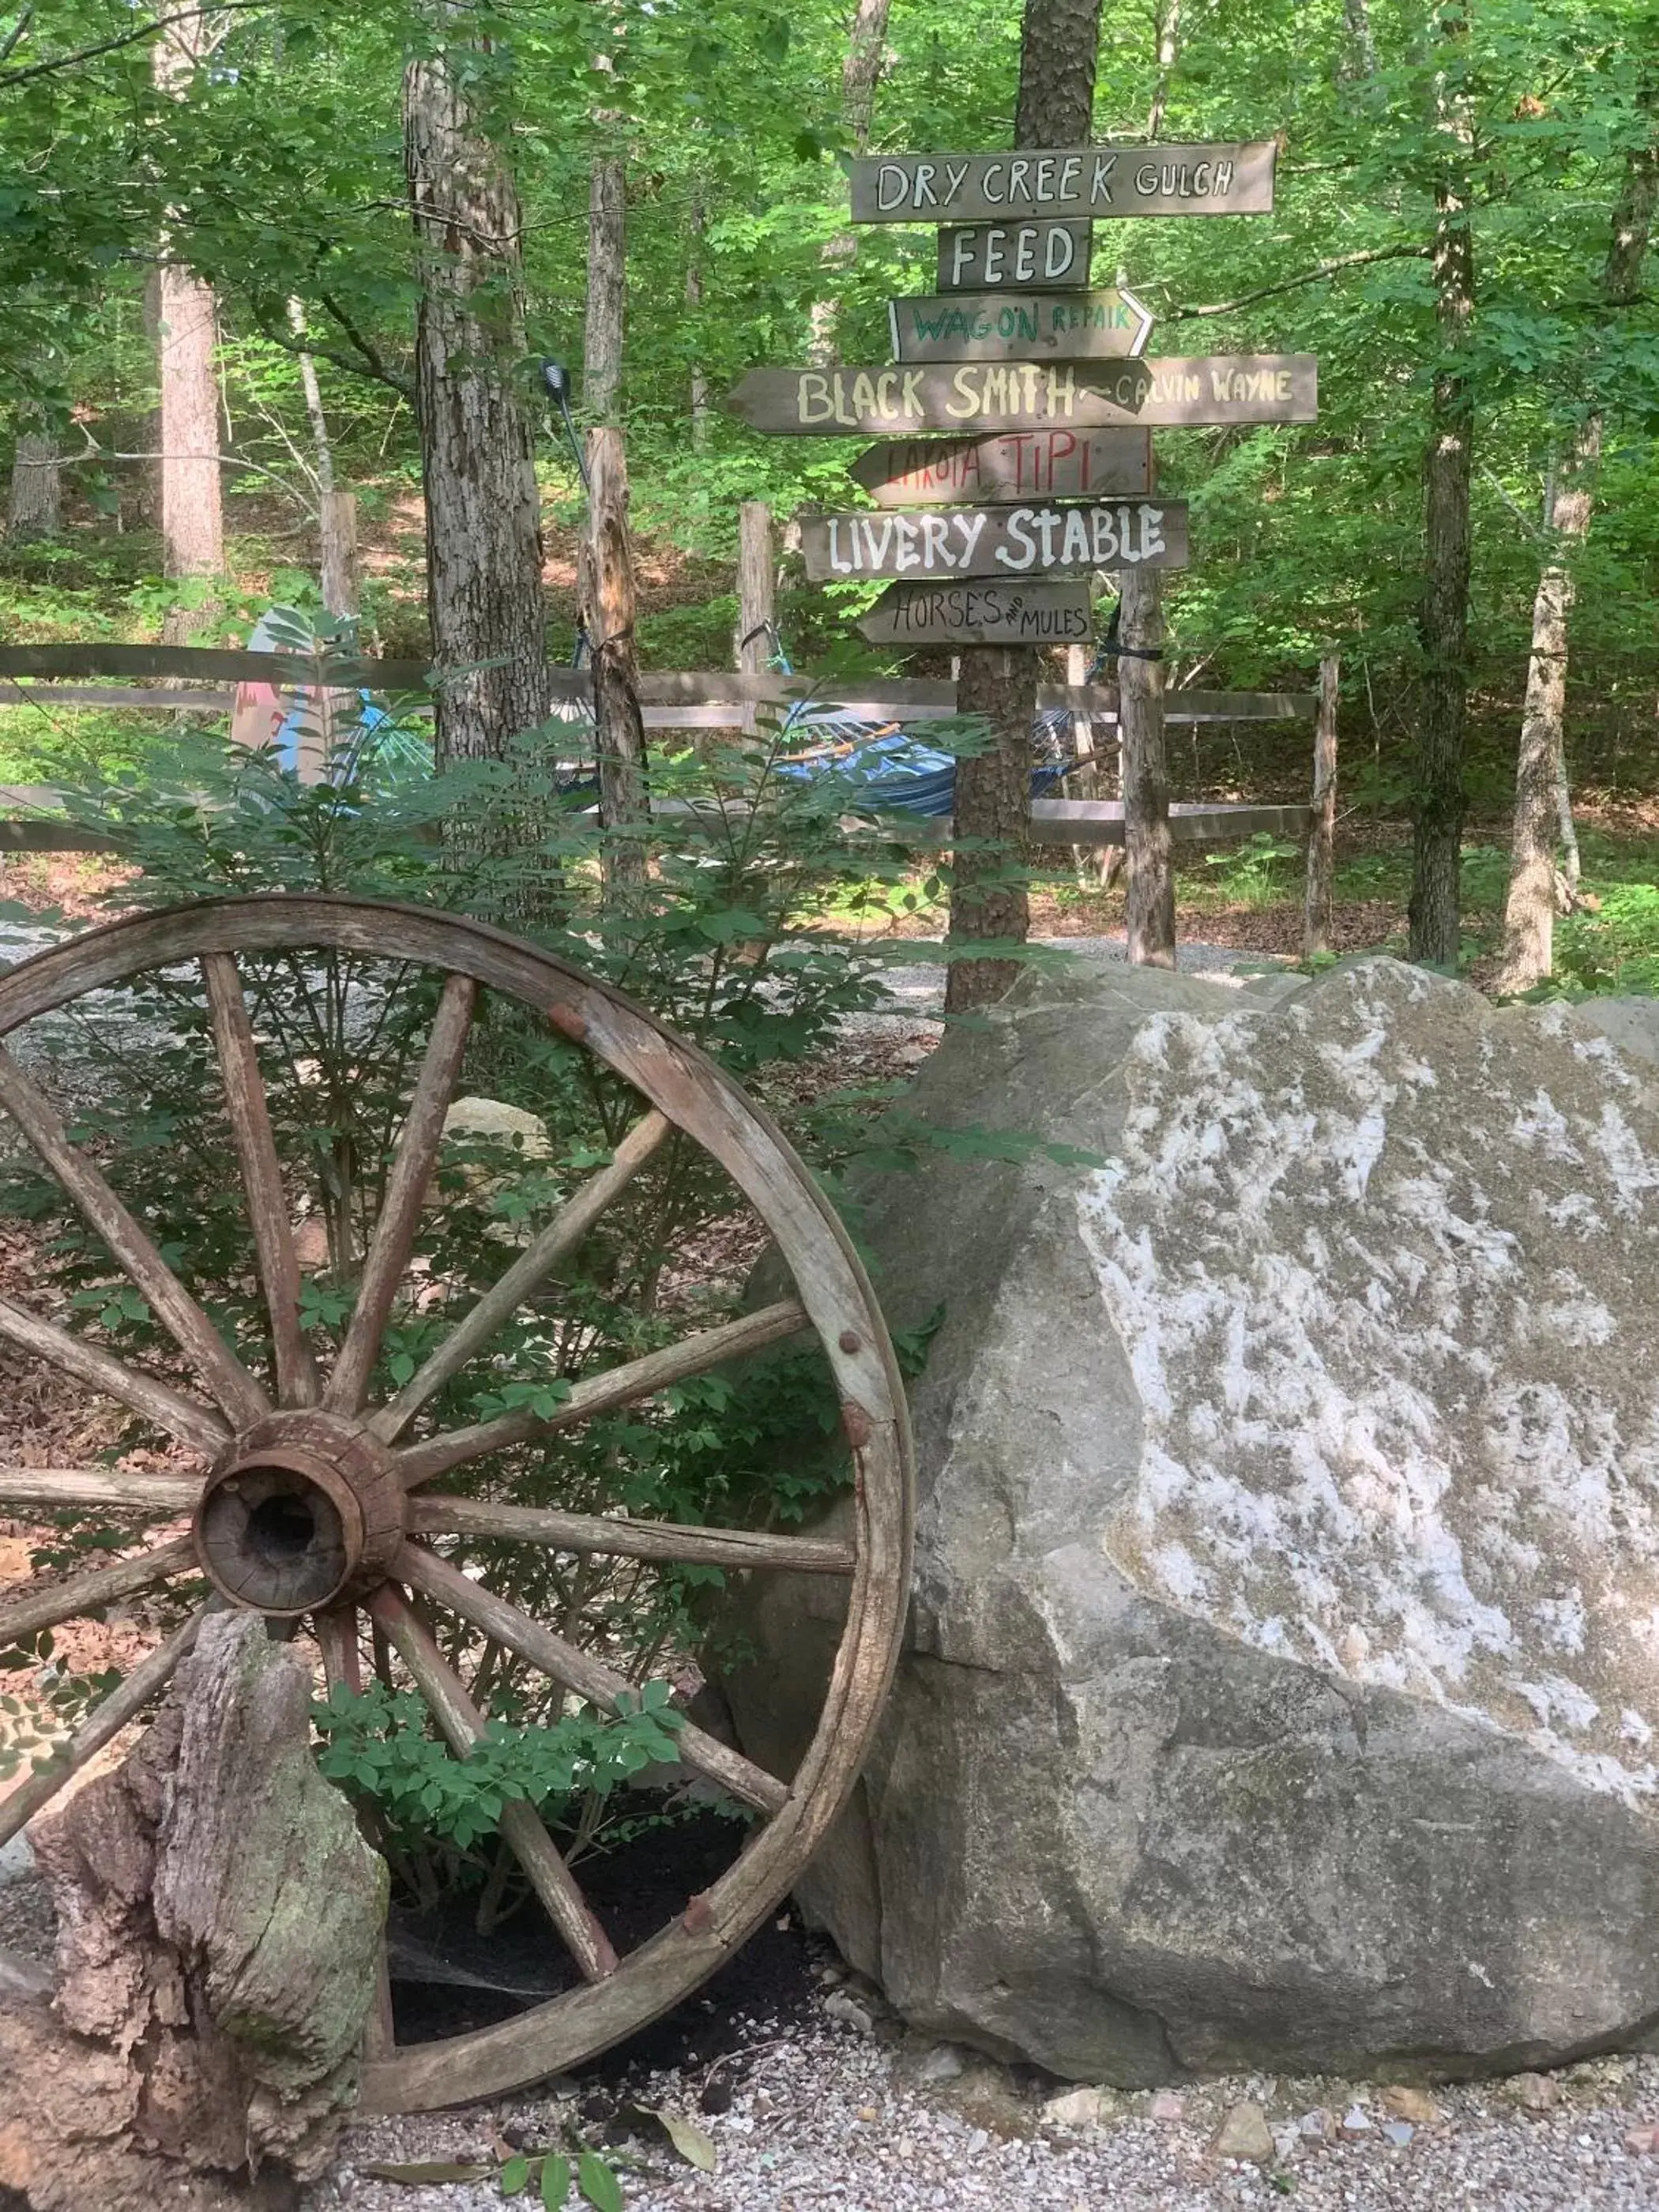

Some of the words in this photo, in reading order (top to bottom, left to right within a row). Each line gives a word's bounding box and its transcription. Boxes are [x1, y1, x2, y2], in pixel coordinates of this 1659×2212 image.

[878, 162, 969, 211] DRY
[983, 154, 1118, 205] CREEK
[1134, 161, 1234, 197] GULCH
[952, 227, 1075, 285] FEED
[914, 303, 1039, 344] WAGON
[1051, 303, 1130, 333] REPAIR
[797, 371, 925, 426] BLACK
[946, 364, 1074, 419] SMITH
[1115, 372, 1201, 404] CALVIN
[1210, 368, 1292, 401] WAYNE
[886, 442, 980, 491] LAKOTA
[827, 513, 987, 573] LIVERY
[995, 504, 1165, 570] STABLE
[1006, 596, 1024, 625] AND
[1021, 608, 1088, 637] MULES
